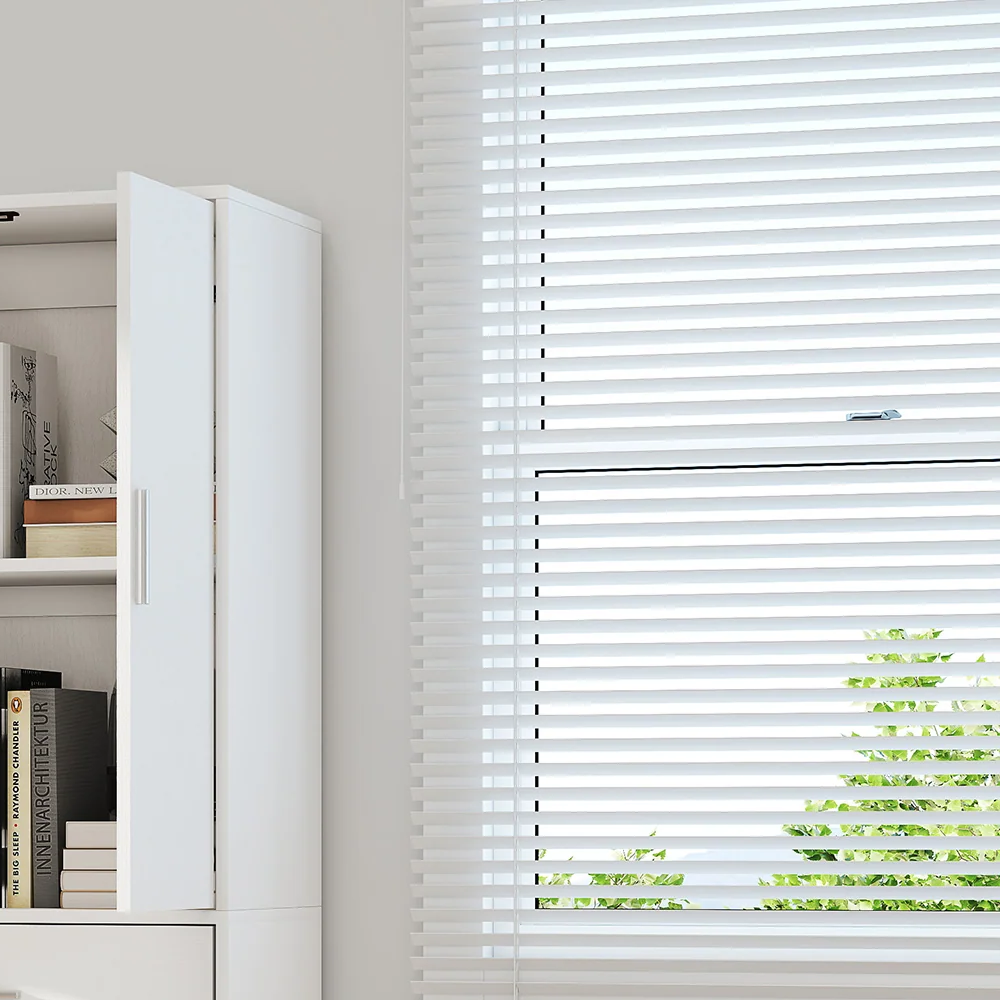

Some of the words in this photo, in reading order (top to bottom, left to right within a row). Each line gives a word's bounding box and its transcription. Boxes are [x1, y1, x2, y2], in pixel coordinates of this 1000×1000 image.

[74, 487, 105, 495] NEW
[12, 720, 20, 768] CHANDLER
[12, 772, 20, 819] RAYMOND
[33, 702, 52, 875] INNENARCHITEKTUR
[12, 831, 20, 856] SLEEP
[12, 860, 20, 876] BIG
[12, 879, 20, 896] THE
